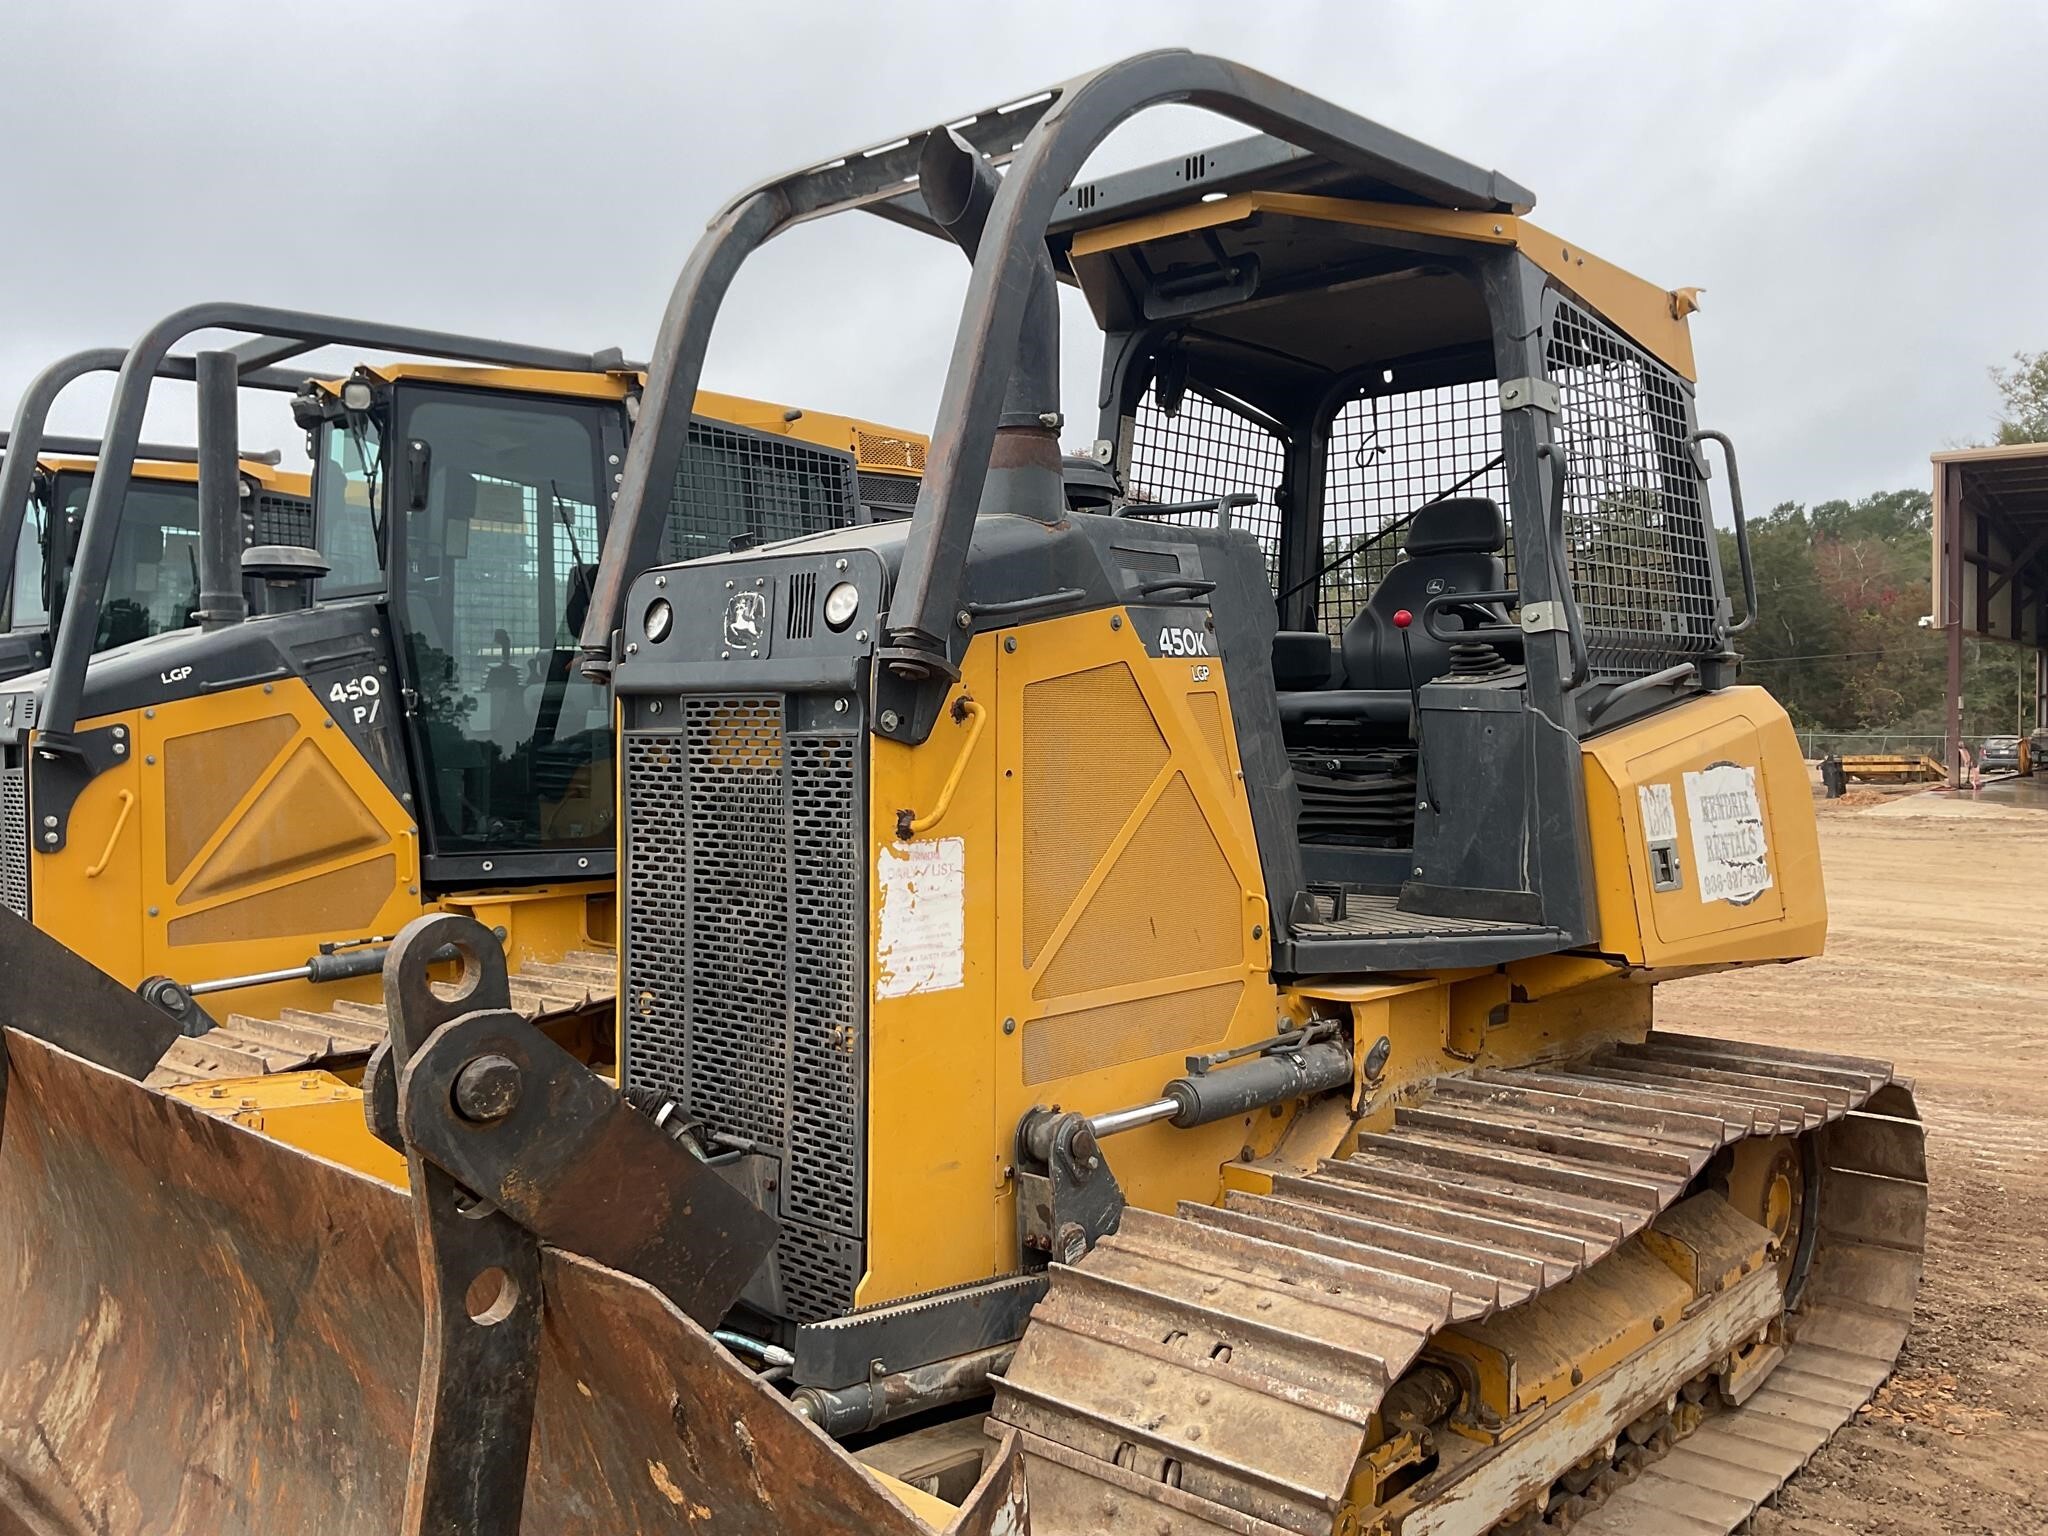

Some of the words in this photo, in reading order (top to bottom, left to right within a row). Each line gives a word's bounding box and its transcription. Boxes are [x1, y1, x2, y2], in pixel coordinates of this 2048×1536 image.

[1159, 627, 1208, 656] 450K
[160, 665, 193, 685] LGP
[1191, 665, 1210, 682] LGP
[329, 675, 380, 703] 450
[1704, 827, 1758, 862] RENTALS
